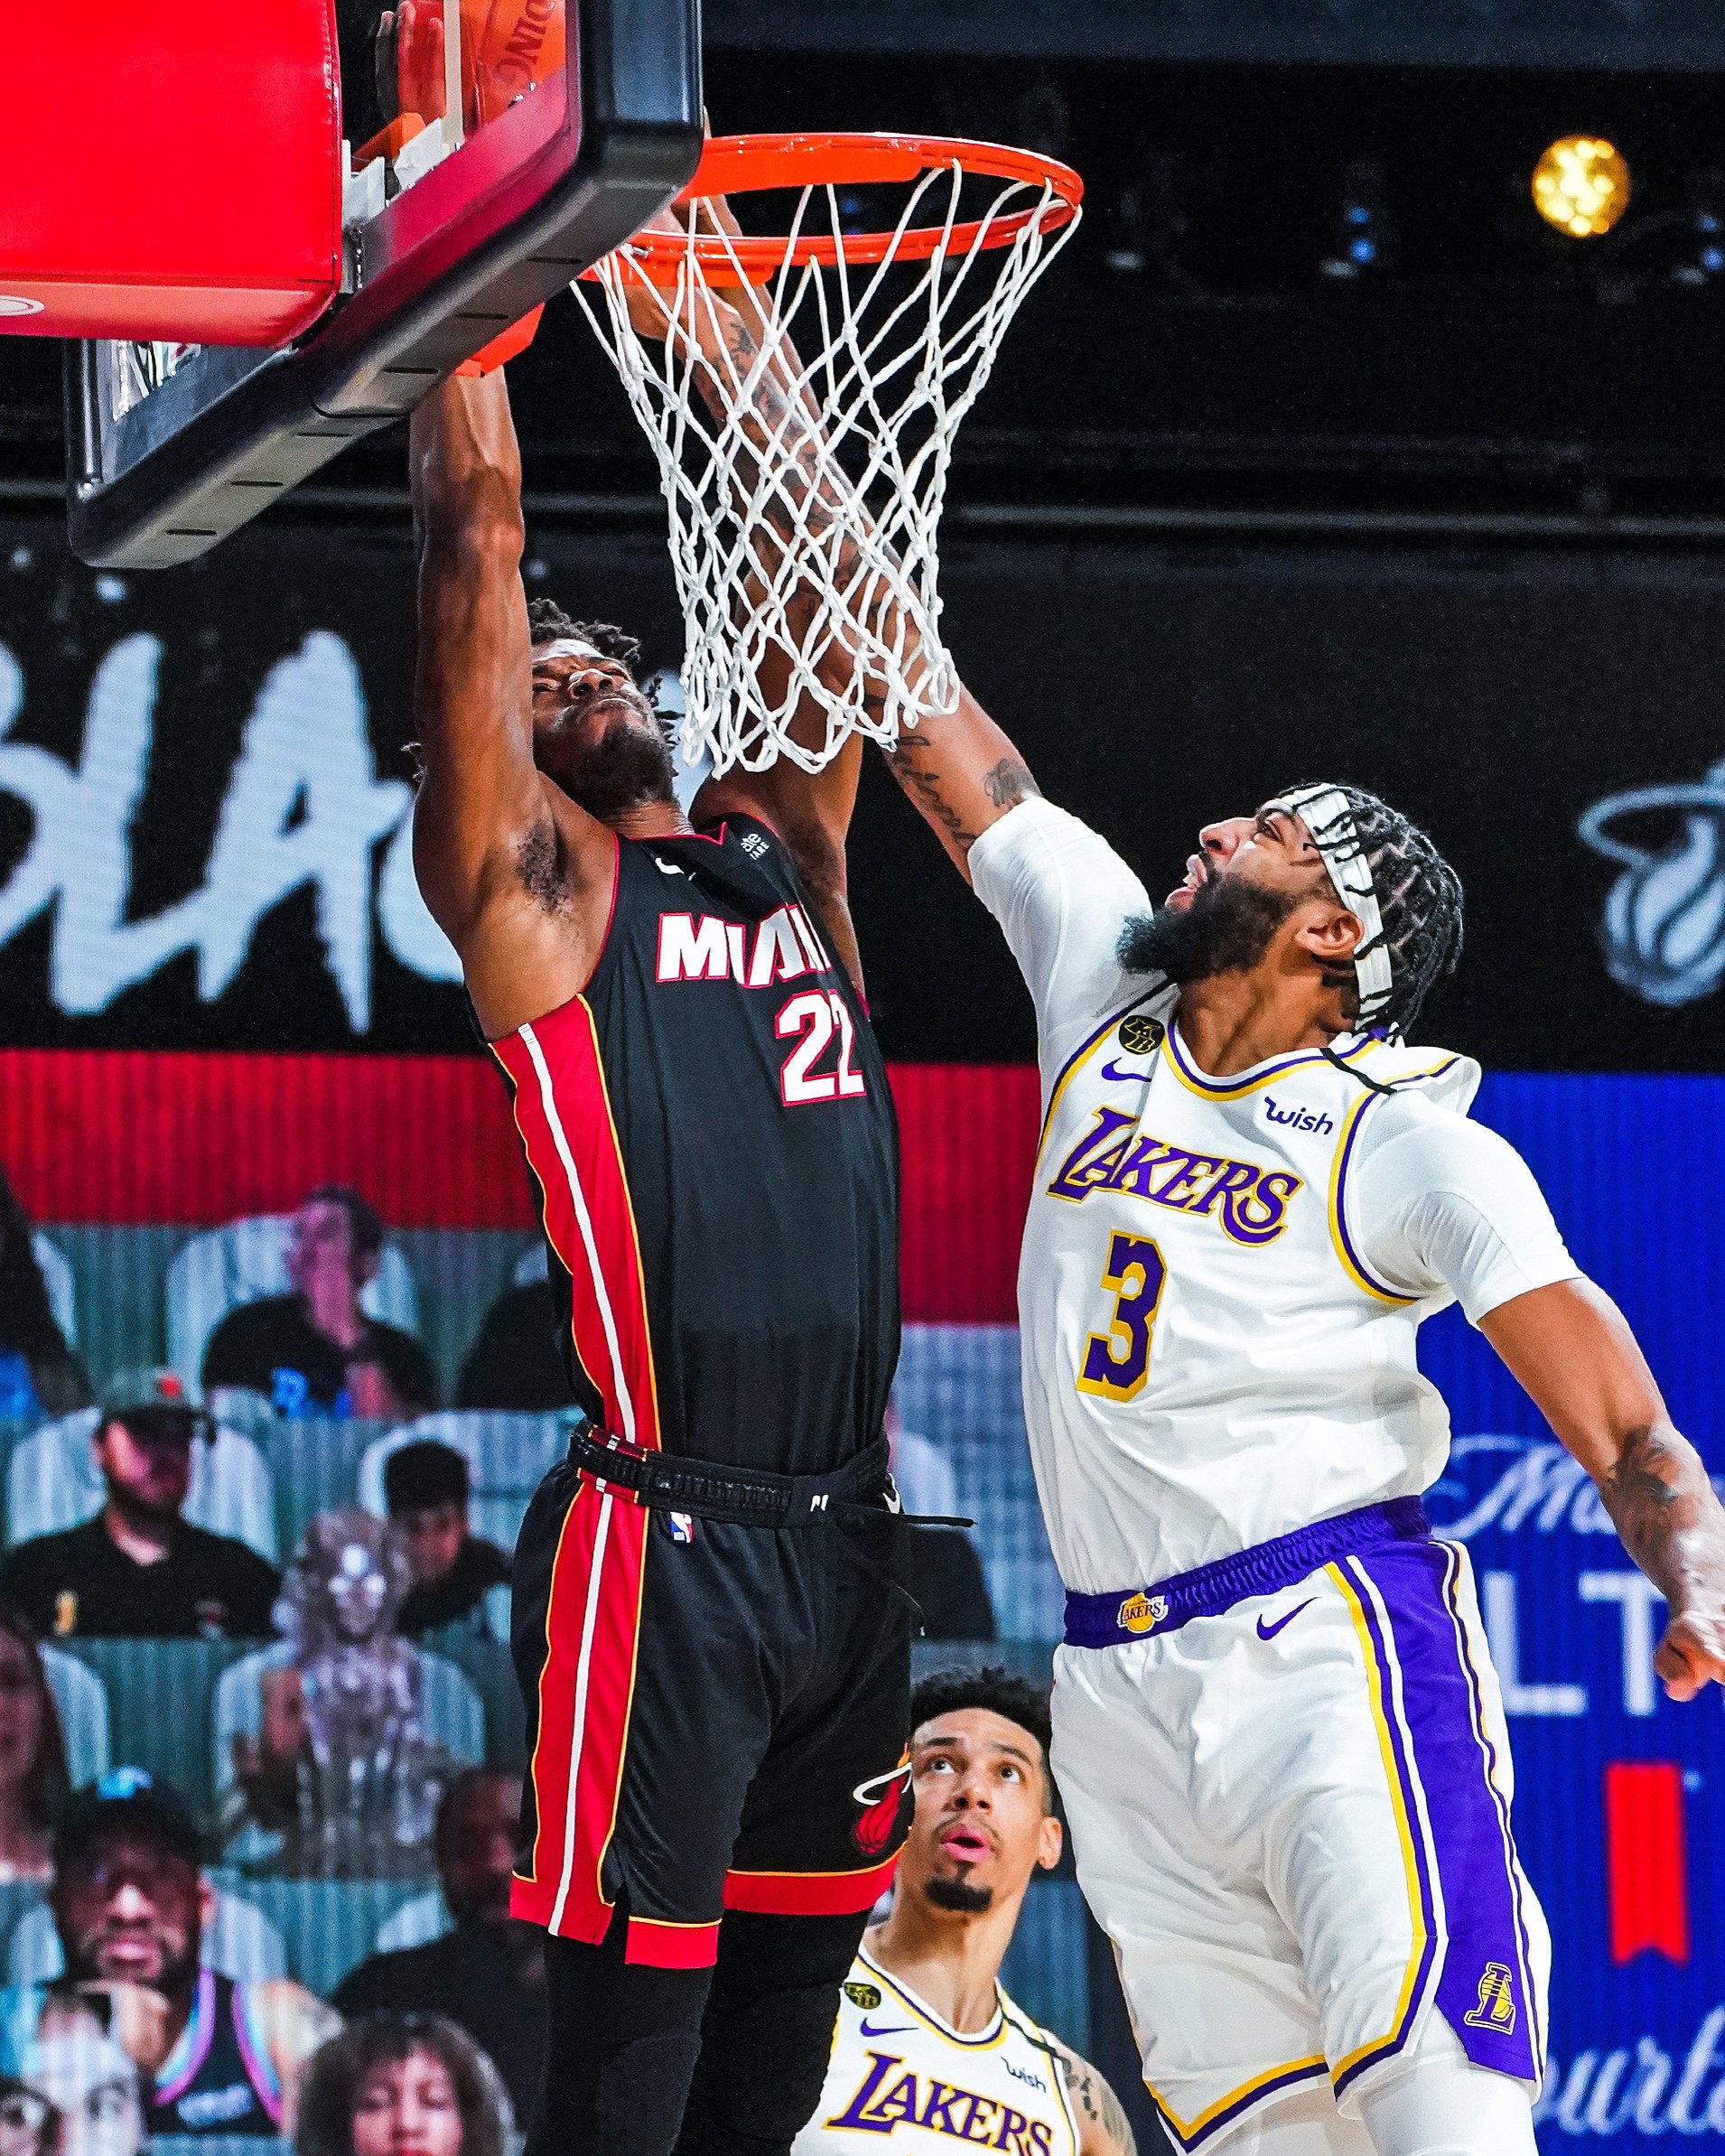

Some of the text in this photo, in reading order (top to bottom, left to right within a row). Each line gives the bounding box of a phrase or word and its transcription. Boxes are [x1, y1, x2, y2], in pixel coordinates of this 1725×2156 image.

[774, 988, 867, 1107] 22
[1046, 1104, 1305, 1248] LAKERS
[1076, 1227, 1168, 1403] 3
[1117, 1597, 1169, 1628] LAKERS
